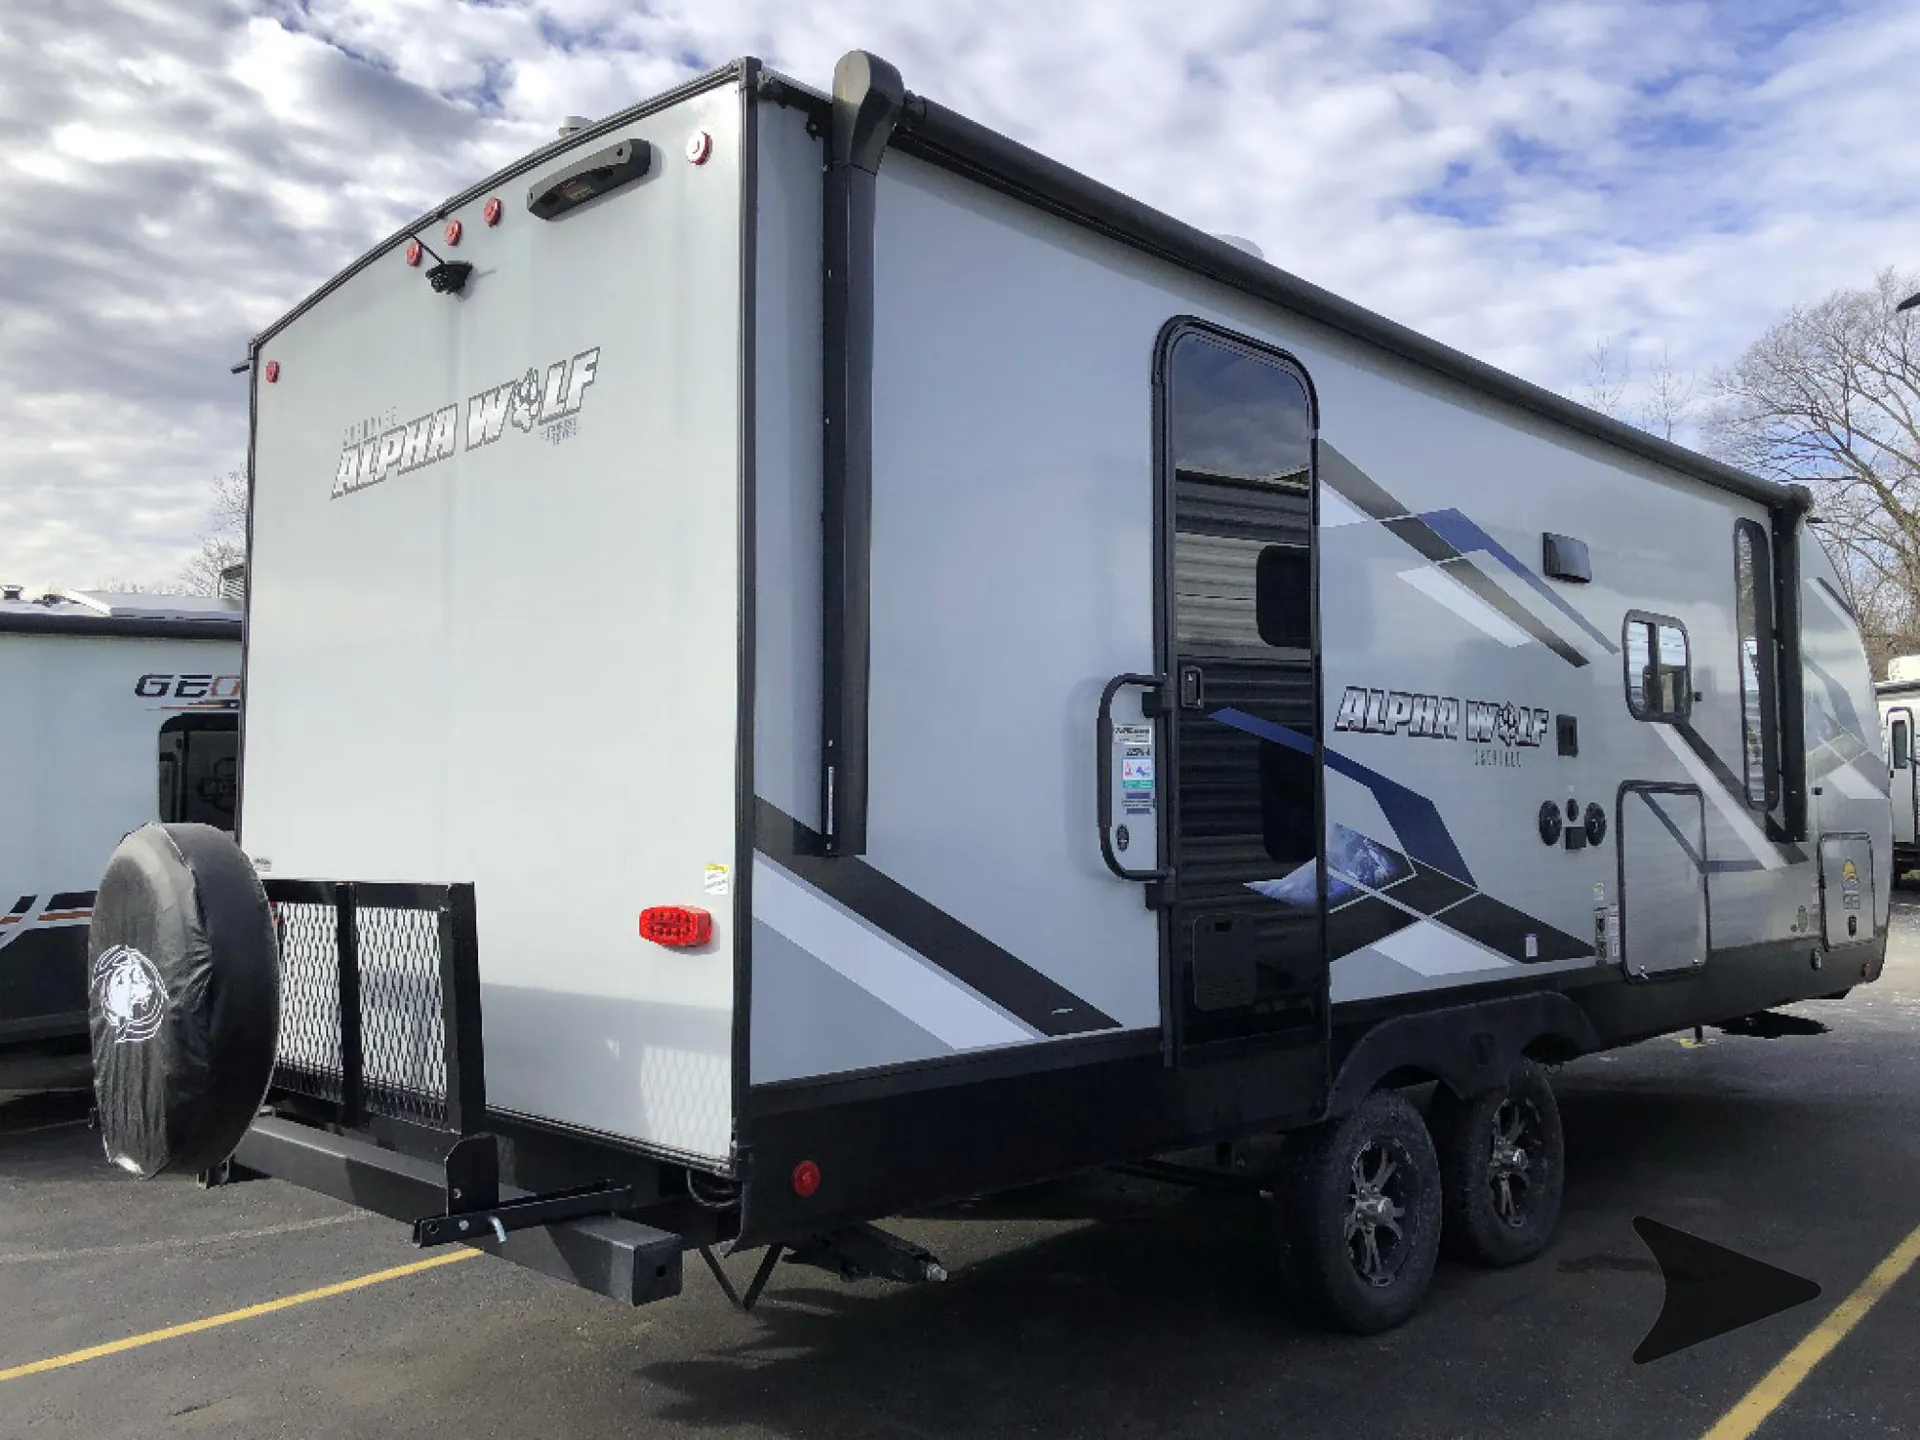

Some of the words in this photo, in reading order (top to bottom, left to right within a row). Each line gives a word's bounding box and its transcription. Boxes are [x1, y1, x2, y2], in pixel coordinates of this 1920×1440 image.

[330, 403, 459, 500] ALPHA
[134, 674, 241, 697] GEO
[1334, 686, 1459, 740] ALPHA
